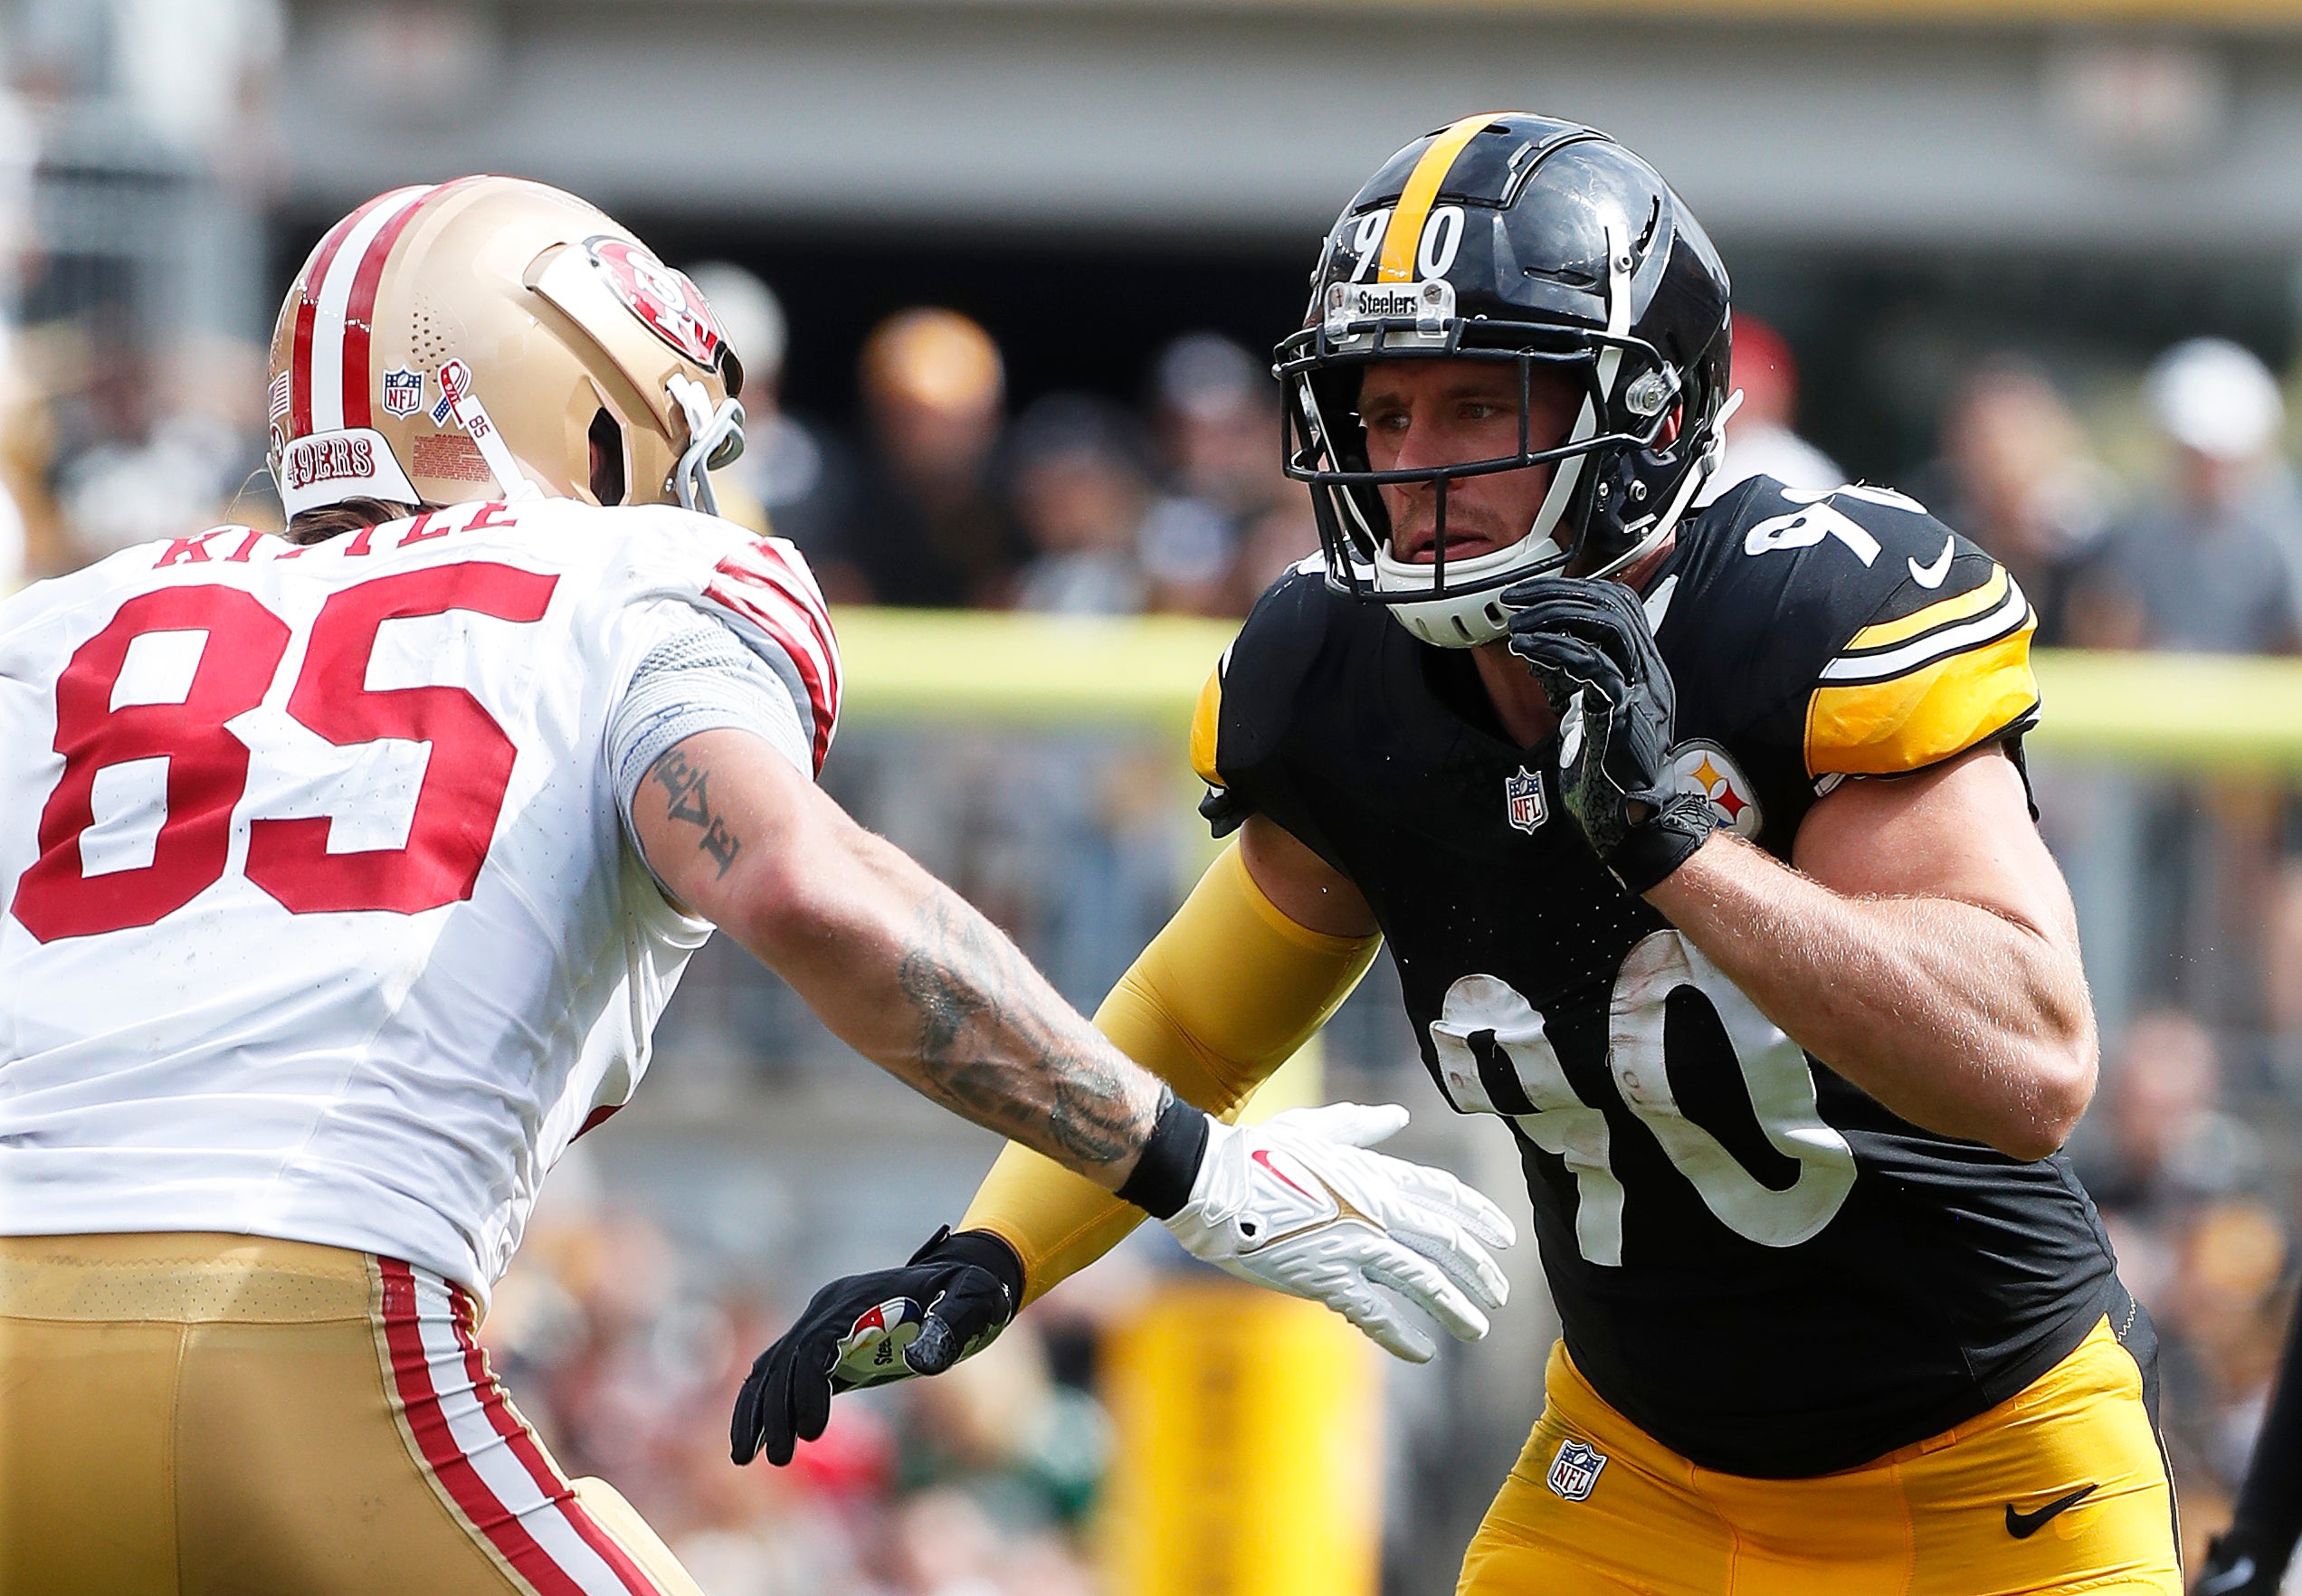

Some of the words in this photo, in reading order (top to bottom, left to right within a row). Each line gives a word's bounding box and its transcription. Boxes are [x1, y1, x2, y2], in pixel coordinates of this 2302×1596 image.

[1349, 205, 1465, 283] 90
[1359, 290, 1417, 314] Steelers
[388, 389, 416, 410] NFL
[469, 415, 490, 439] 85
[288, 438, 376, 489] 49ERS
[152, 500, 519, 569] KILE
[13, 560, 562, 945] 85
[652, 749, 741, 881] EVE
[1513, 797, 1542, 822] NFL
[1430, 928, 1858, 1267] 90
[1554, 1462, 1586, 1492] NFL
